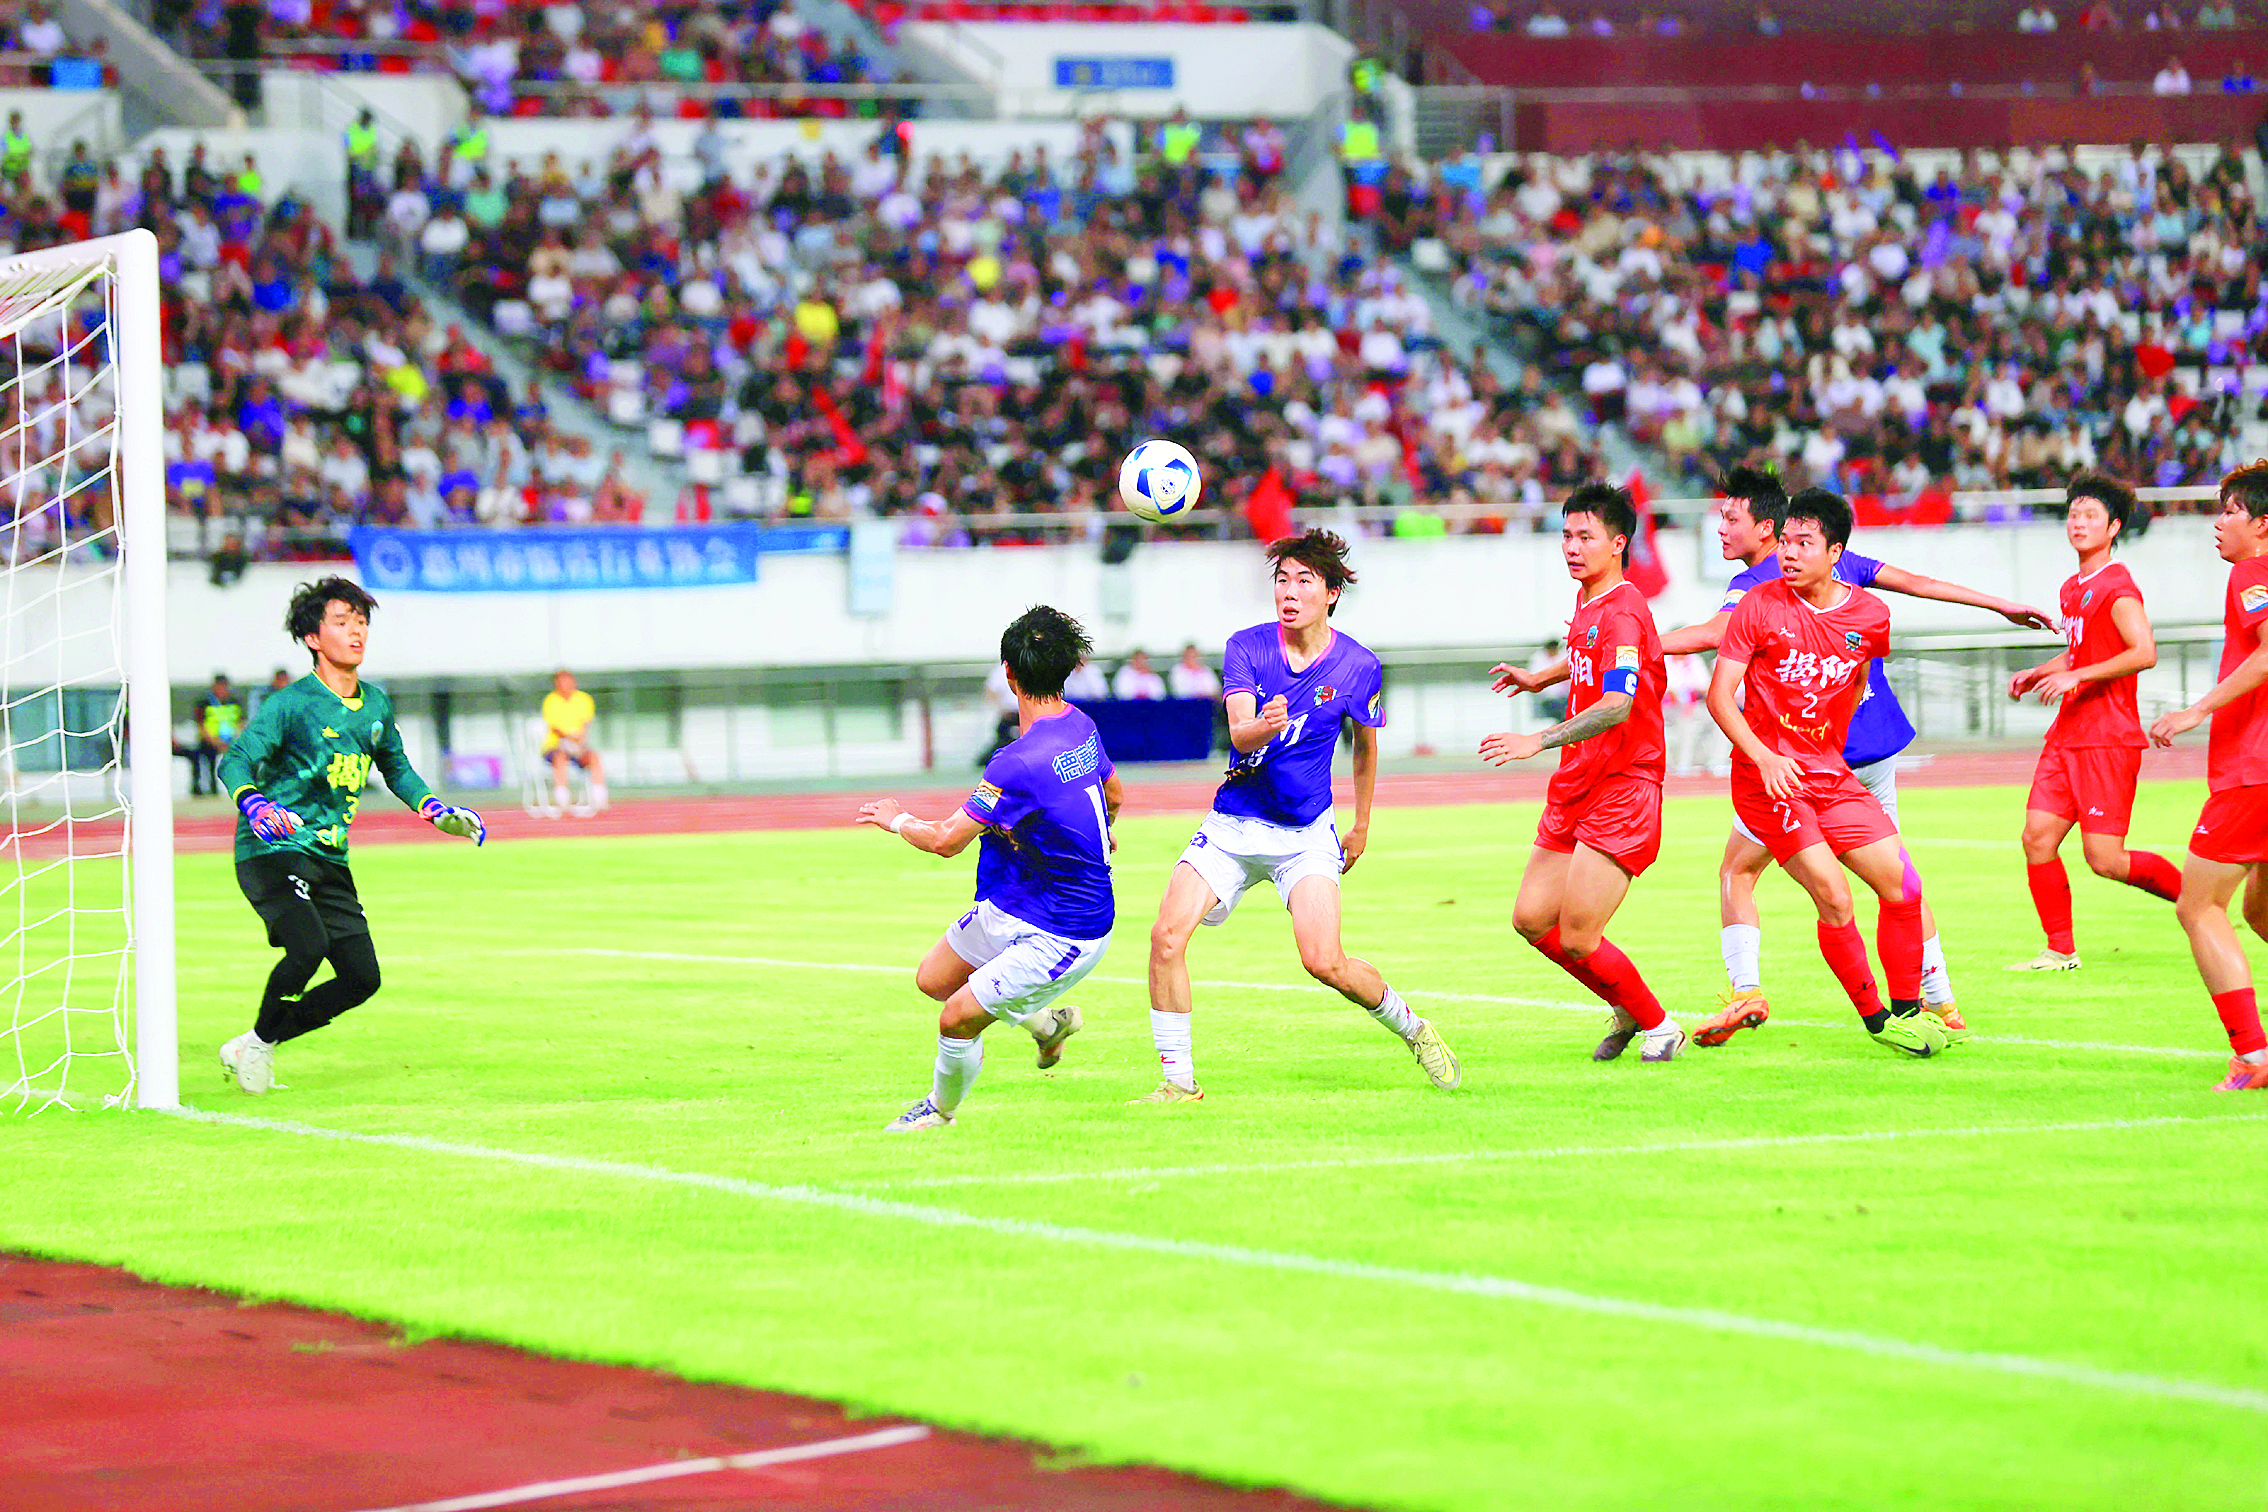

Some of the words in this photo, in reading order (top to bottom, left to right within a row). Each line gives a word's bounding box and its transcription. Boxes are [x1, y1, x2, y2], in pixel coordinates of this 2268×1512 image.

[1775, 648, 1859, 689] 揭阳
[1801, 692, 1818, 719] 2
[1772, 800, 1802, 834] 2
